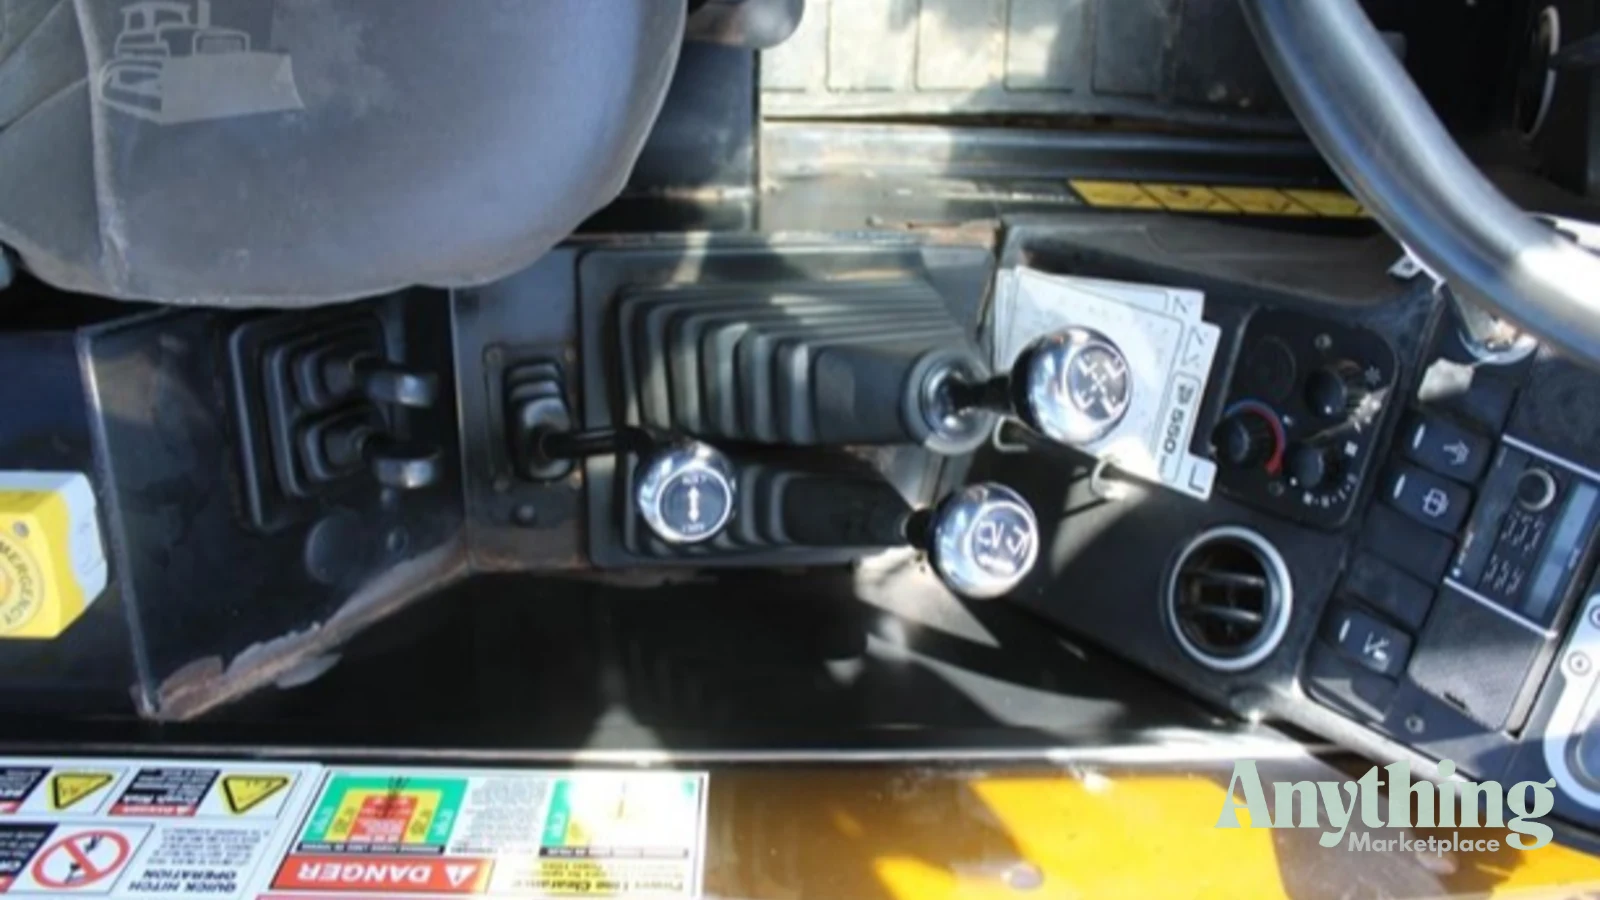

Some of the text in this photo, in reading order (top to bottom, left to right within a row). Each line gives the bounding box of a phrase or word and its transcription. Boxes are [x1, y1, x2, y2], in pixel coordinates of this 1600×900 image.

[0, 540, 34, 625] MERGENCY
[143, 870, 237, 881] OPERATION
[296, 862, 432, 884] DANGER
[128, 880, 237, 893] QUICK HITCH
